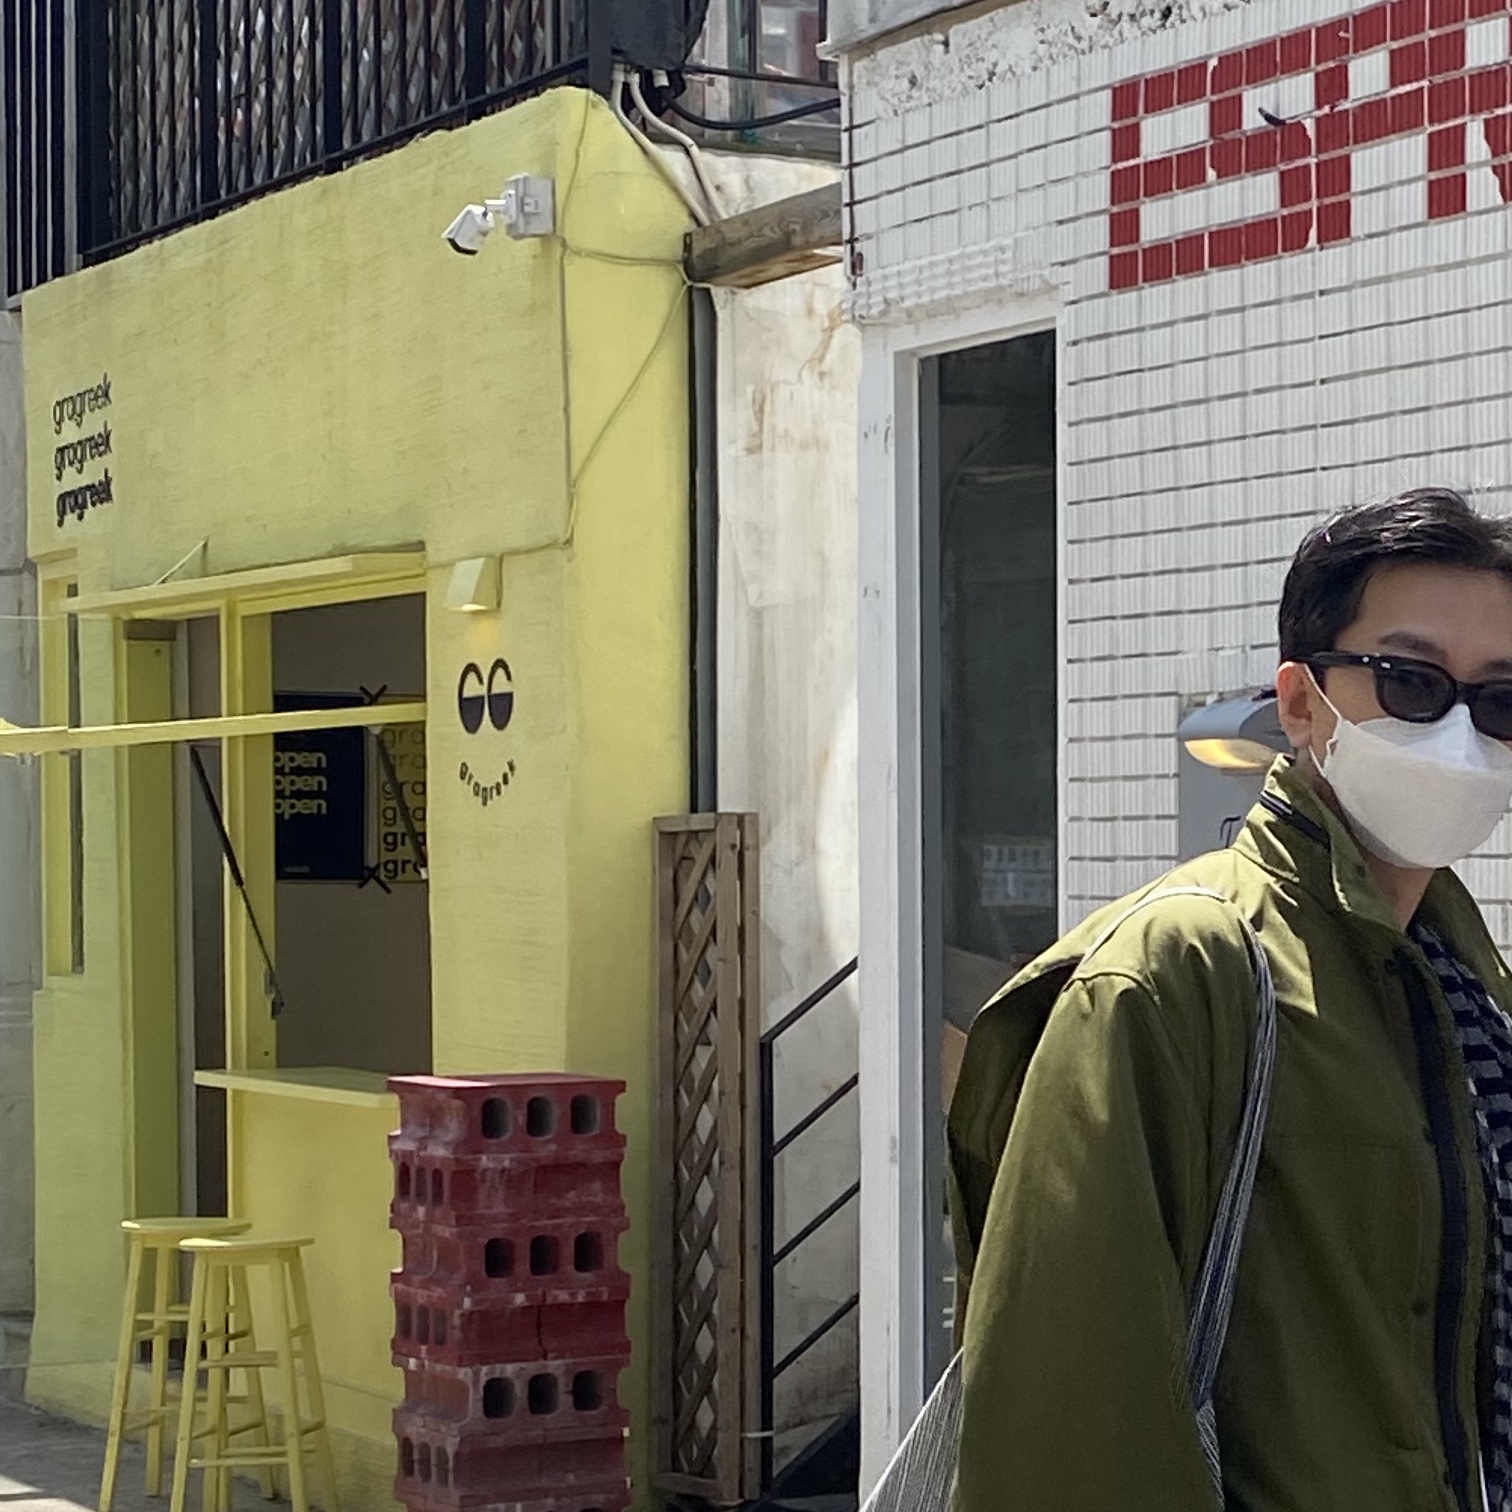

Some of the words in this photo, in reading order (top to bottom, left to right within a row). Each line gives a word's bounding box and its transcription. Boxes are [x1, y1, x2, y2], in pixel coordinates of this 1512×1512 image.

[53, 372, 112, 435] grogreek
[55, 420, 113, 481] grogreek
[57, 467, 113, 528] grogreek
[274, 752, 327, 773] open
[274, 775, 327, 796] open
[460, 760, 516, 806] grogreek
[274, 798, 327, 820] open
[383, 806, 426, 828] go
